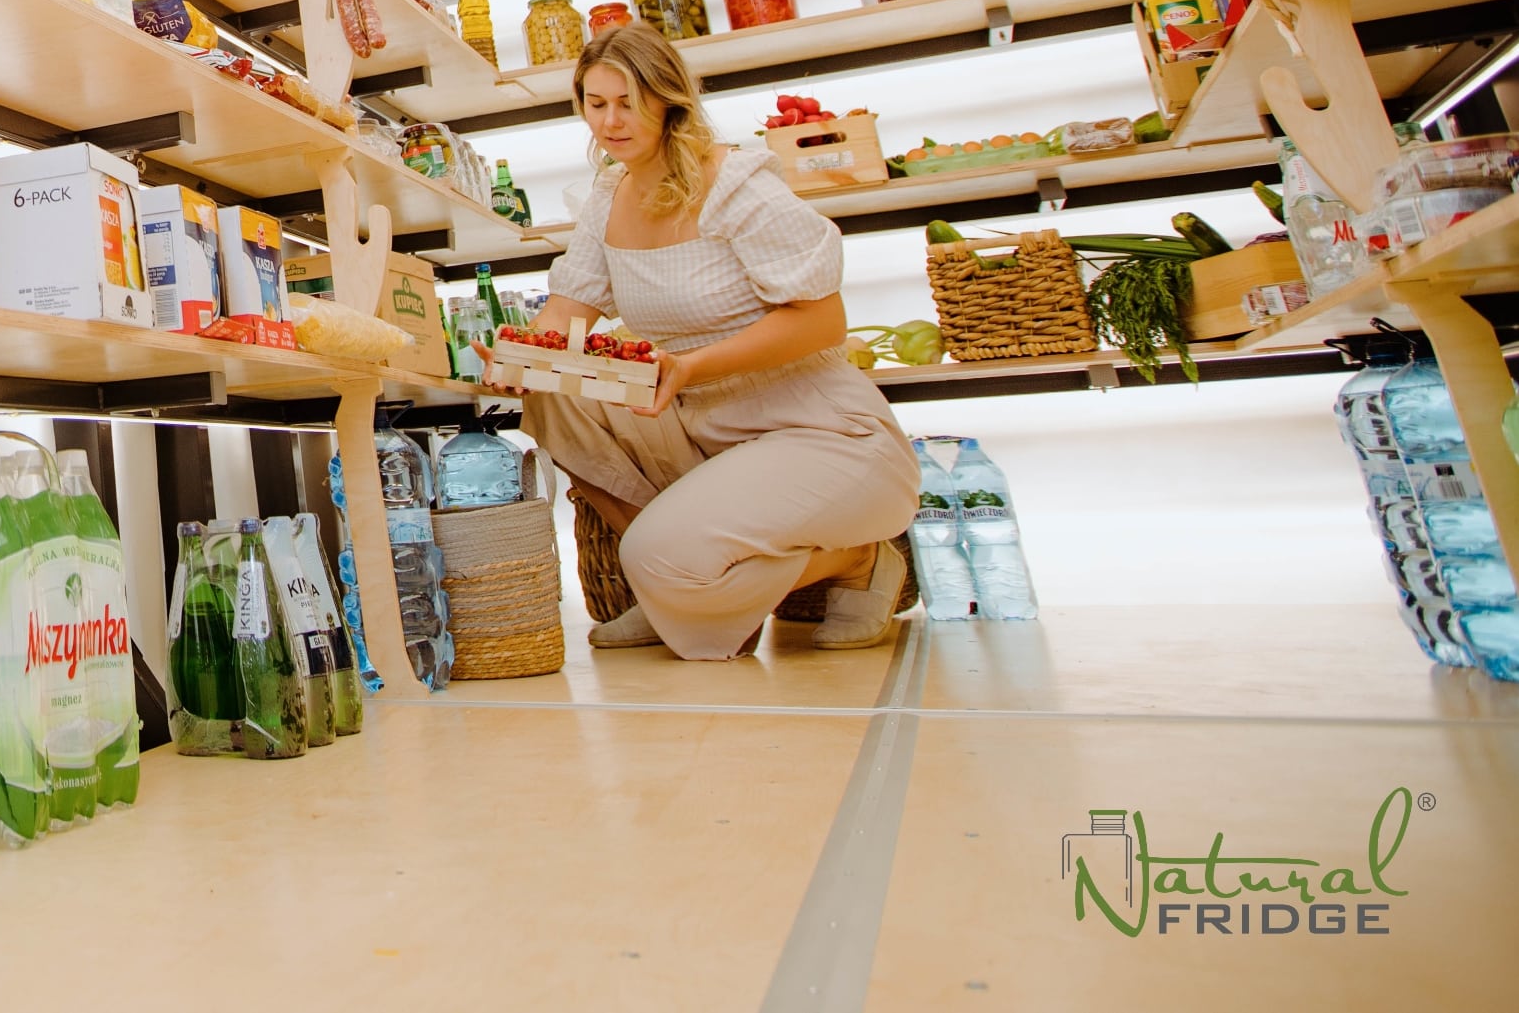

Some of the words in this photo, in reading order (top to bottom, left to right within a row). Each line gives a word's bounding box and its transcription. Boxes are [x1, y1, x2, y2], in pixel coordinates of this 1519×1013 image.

[1162, 10, 1196, 21] CENOS
[142, 17, 185, 35] GLUTEN
[14, 186, 72, 208] 6-PACK
[492, 194, 515, 207] errier
[255, 256, 276, 273] KASZA
[394, 294, 425, 315] KUPIEC
[287, 567, 320, 598] KIA
[241, 569, 251, 630] KINGA
